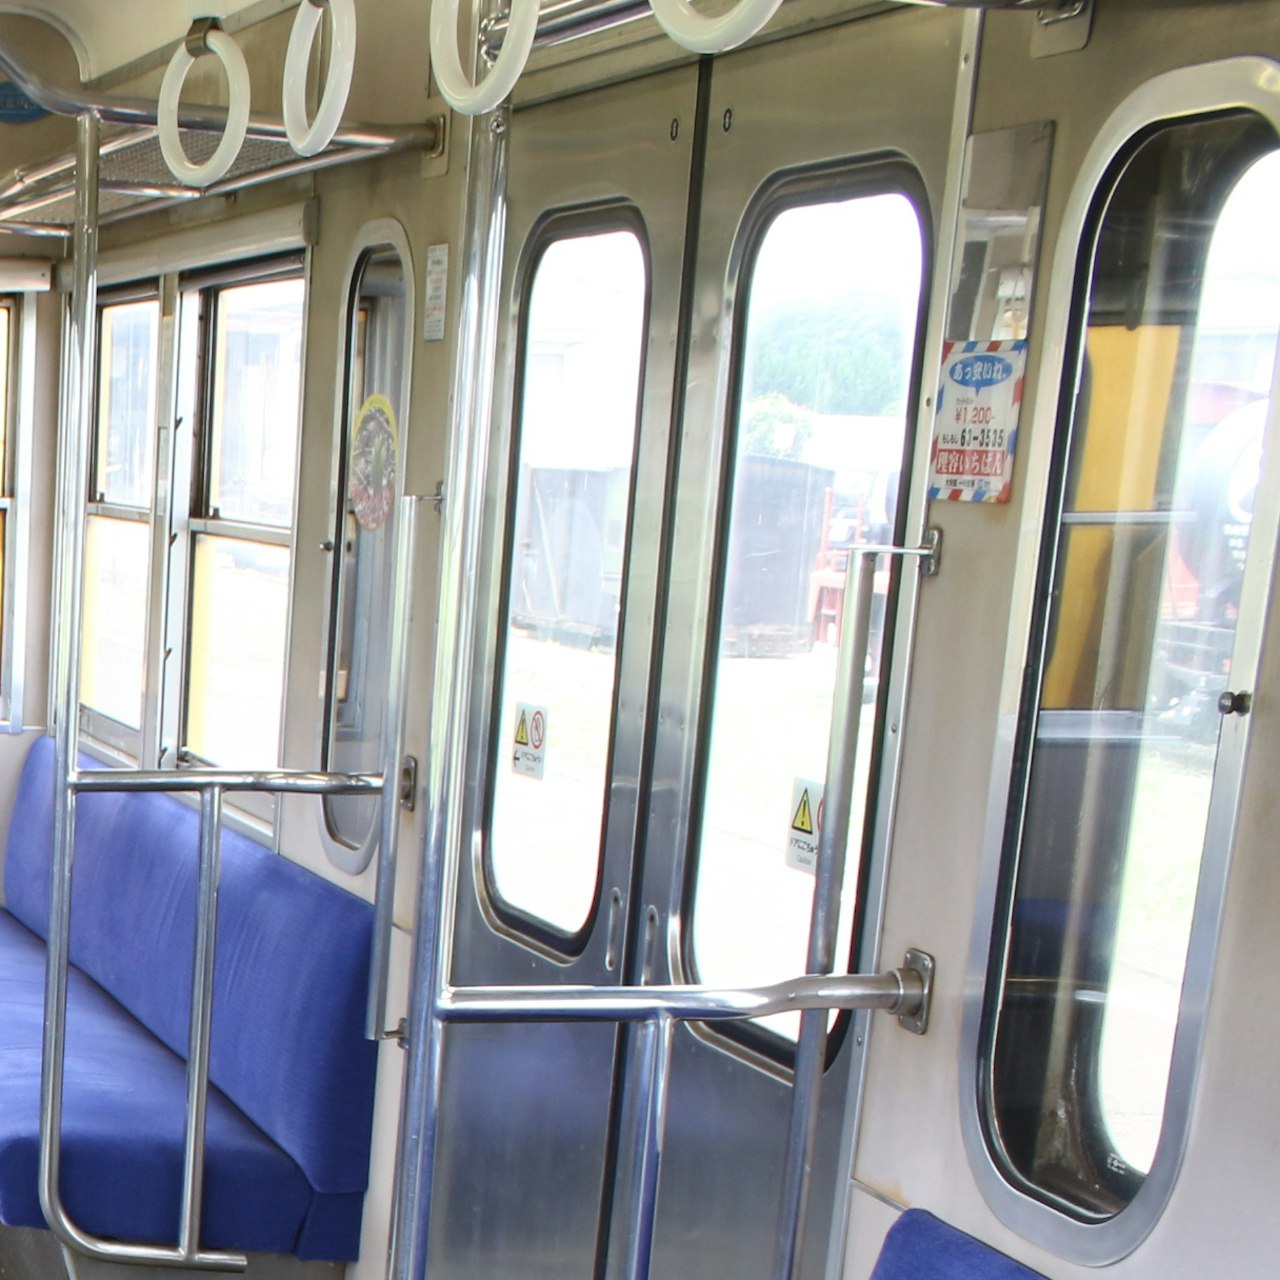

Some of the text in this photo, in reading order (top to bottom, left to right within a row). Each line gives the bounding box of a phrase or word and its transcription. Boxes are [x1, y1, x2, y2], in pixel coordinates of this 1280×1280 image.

[960, 428, 1005, 447] 63-3535
[937, 450, 1003, 474] 理容いちばん
